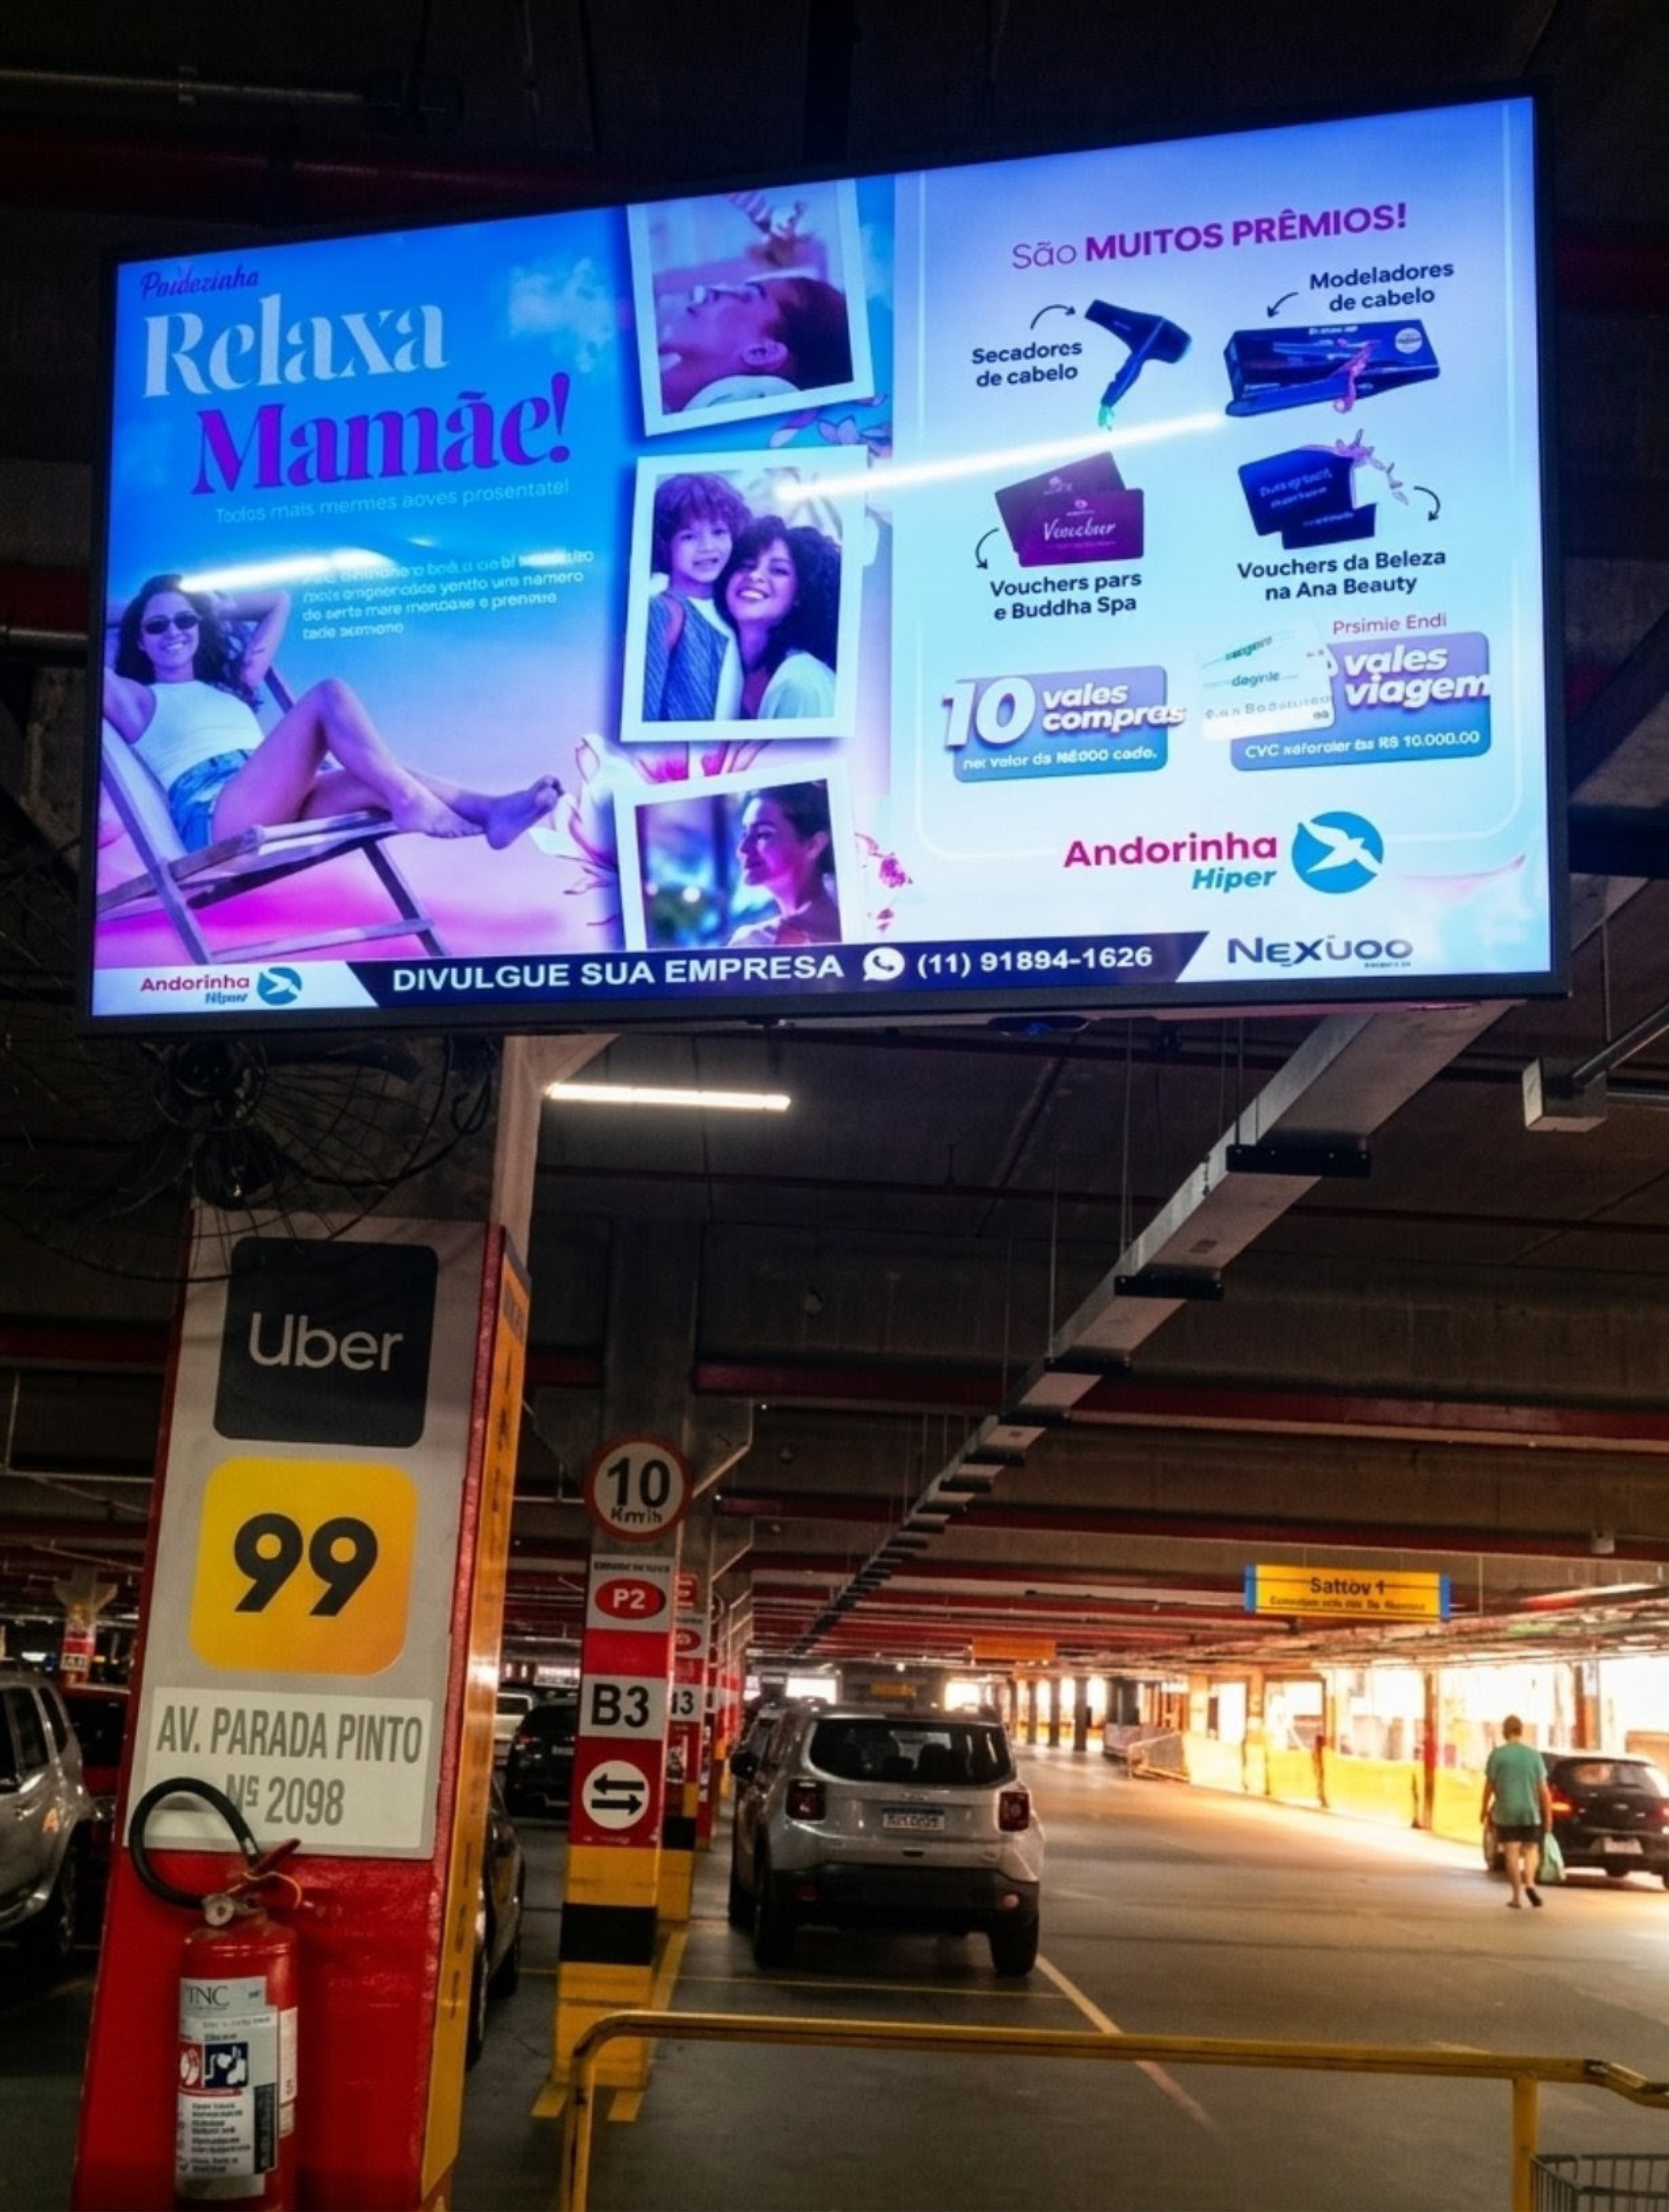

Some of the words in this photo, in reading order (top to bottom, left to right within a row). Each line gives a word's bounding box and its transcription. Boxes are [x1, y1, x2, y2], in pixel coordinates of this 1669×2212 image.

[1012, 240, 1077, 270] São
[1084, 223, 1224, 263] MUITOS
[1232, 203, 1407, 247] PRÊMIOS!
[1309, 261, 1455, 290] Modeladores
[1329, 294, 1356, 312] de
[1359, 288, 1435, 311] cabelo
[143, 294, 450, 397] Relaxa
[971, 340, 1083, 364] Secadores
[976, 368, 1002, 388] de
[1006, 362, 1078, 385] cabelo
[190, 372, 571, 495] Mamãe!
[1238, 554, 1337, 579] Vouchers
[1343, 554, 1369, 574] da
[1375, 548, 1446, 570] Beleza
[990, 573, 1089, 598] Vouchers
[1094, 574, 1142, 595] pars
[1265, 585, 1290, 601] na
[1296, 578, 1337, 599] Ana
[1343, 573, 1418, 599] Beauty
[994, 609, 1006, 621] e
[1012, 598, 1092, 619] Buddha
[1097, 596, 1137, 618] Spa
[1344, 644, 1449, 677] vales
[1345, 674, 1491, 708] viagem
[943, 677, 1036, 747] 10
[1042, 683, 1129, 709] vales
[1042, 705, 1188, 733] compras
[1063, 833, 1278, 869] Andorinha
[1191, 869, 1277, 892] Hiper
[140, 974, 250, 992] Andorinha
[392, 963, 570, 992] DIVULGUE
[581, 961, 655, 985] SUA
[664, 954, 844, 984] EMPRESA
[917, 952, 971, 977] (11)
[979, 947, 1153, 974] 91894-1626
[248, 1312, 403, 1371] Uber
[607, 1457, 670, 1508] 10
[234, 1513, 379, 1617] 99
[613, 1588, 645, 1610] P2
[591, 1683, 649, 1728] B3
[156, 1705, 200, 1753] AV.
[210, 1707, 327, 1759] PARADA
[335, 1713, 423, 1764] PINTO
[265, 1776, 345, 1826] 2098
